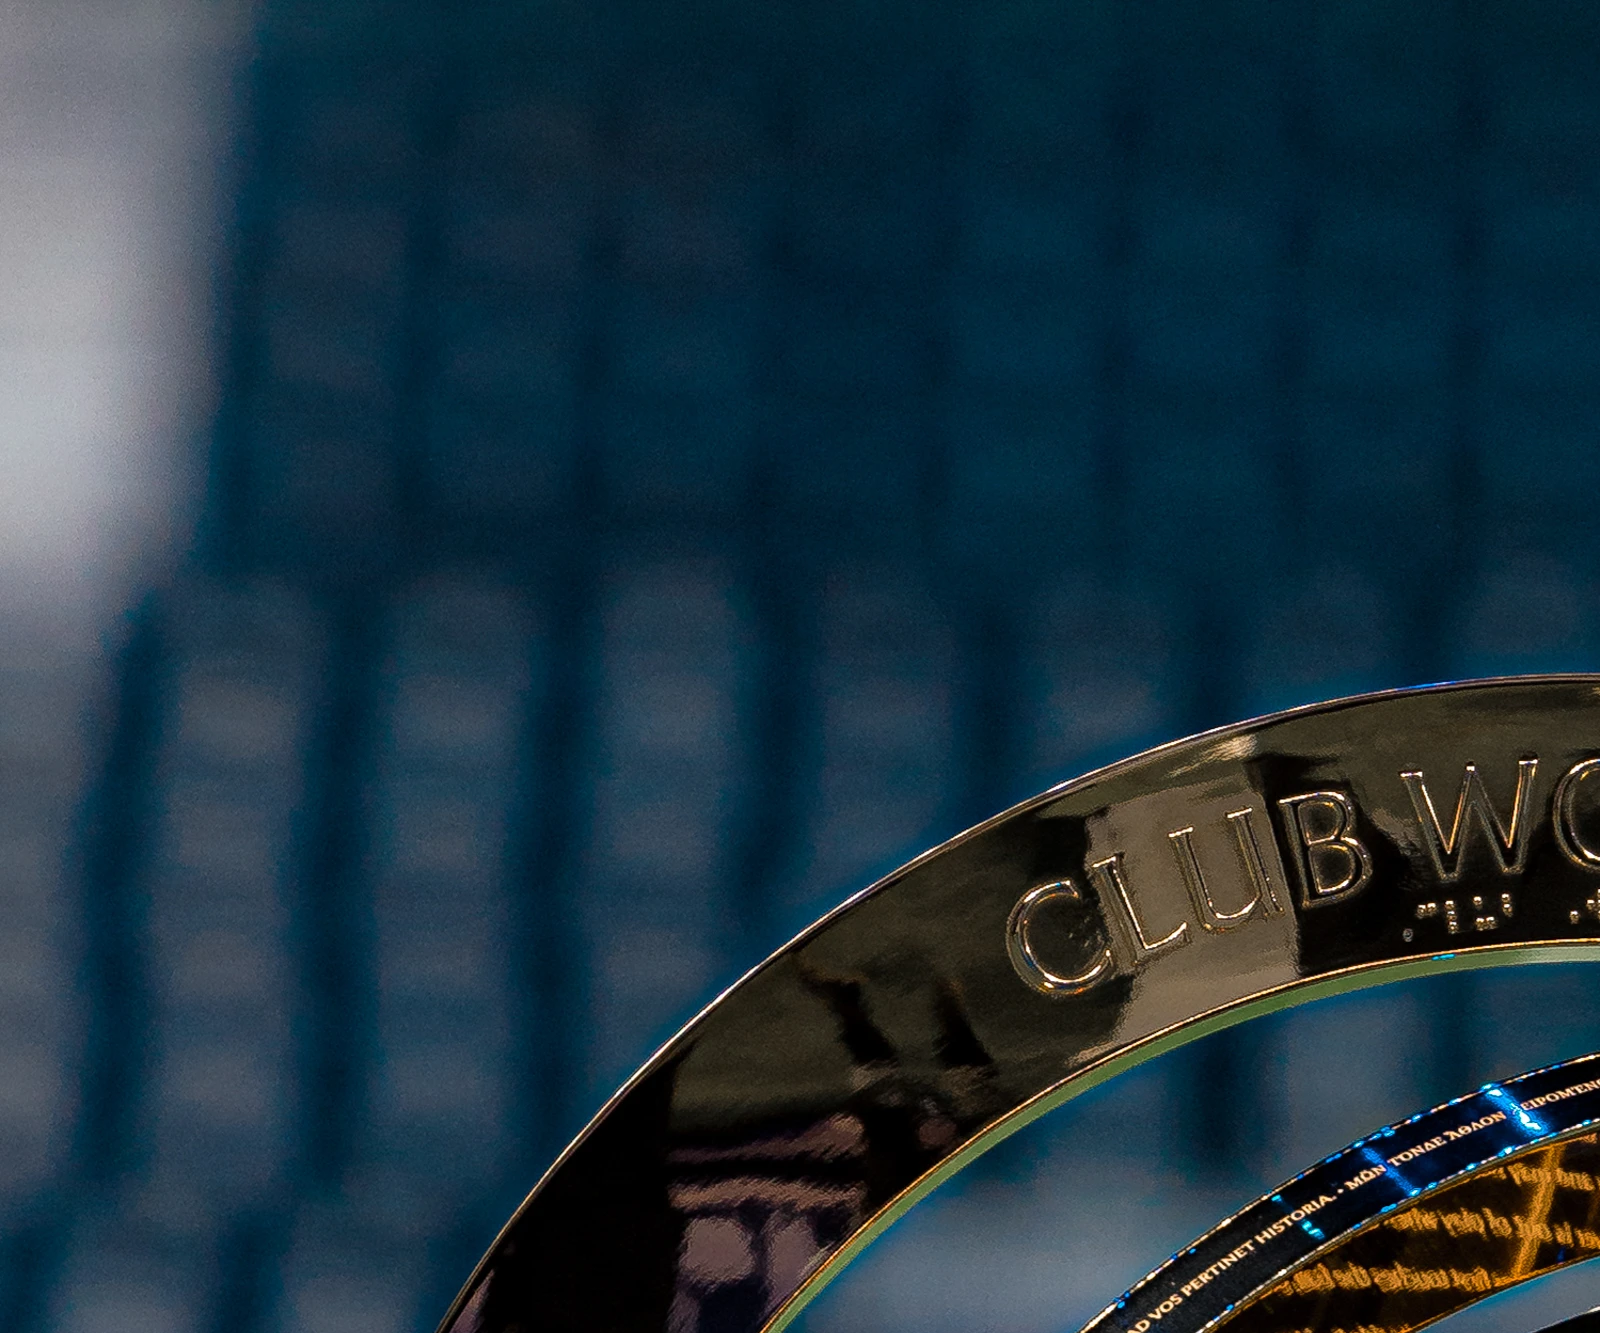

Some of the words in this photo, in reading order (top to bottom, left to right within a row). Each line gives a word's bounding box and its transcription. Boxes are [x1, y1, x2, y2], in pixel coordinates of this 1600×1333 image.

[1005, 790, 1374, 996] CLUB
[1147, 1292, 1183, 1320] VOS
[1179, 1238, 1255, 1297] PERTINET
[1254, 1194, 1337, 1244] HISTORIA.
